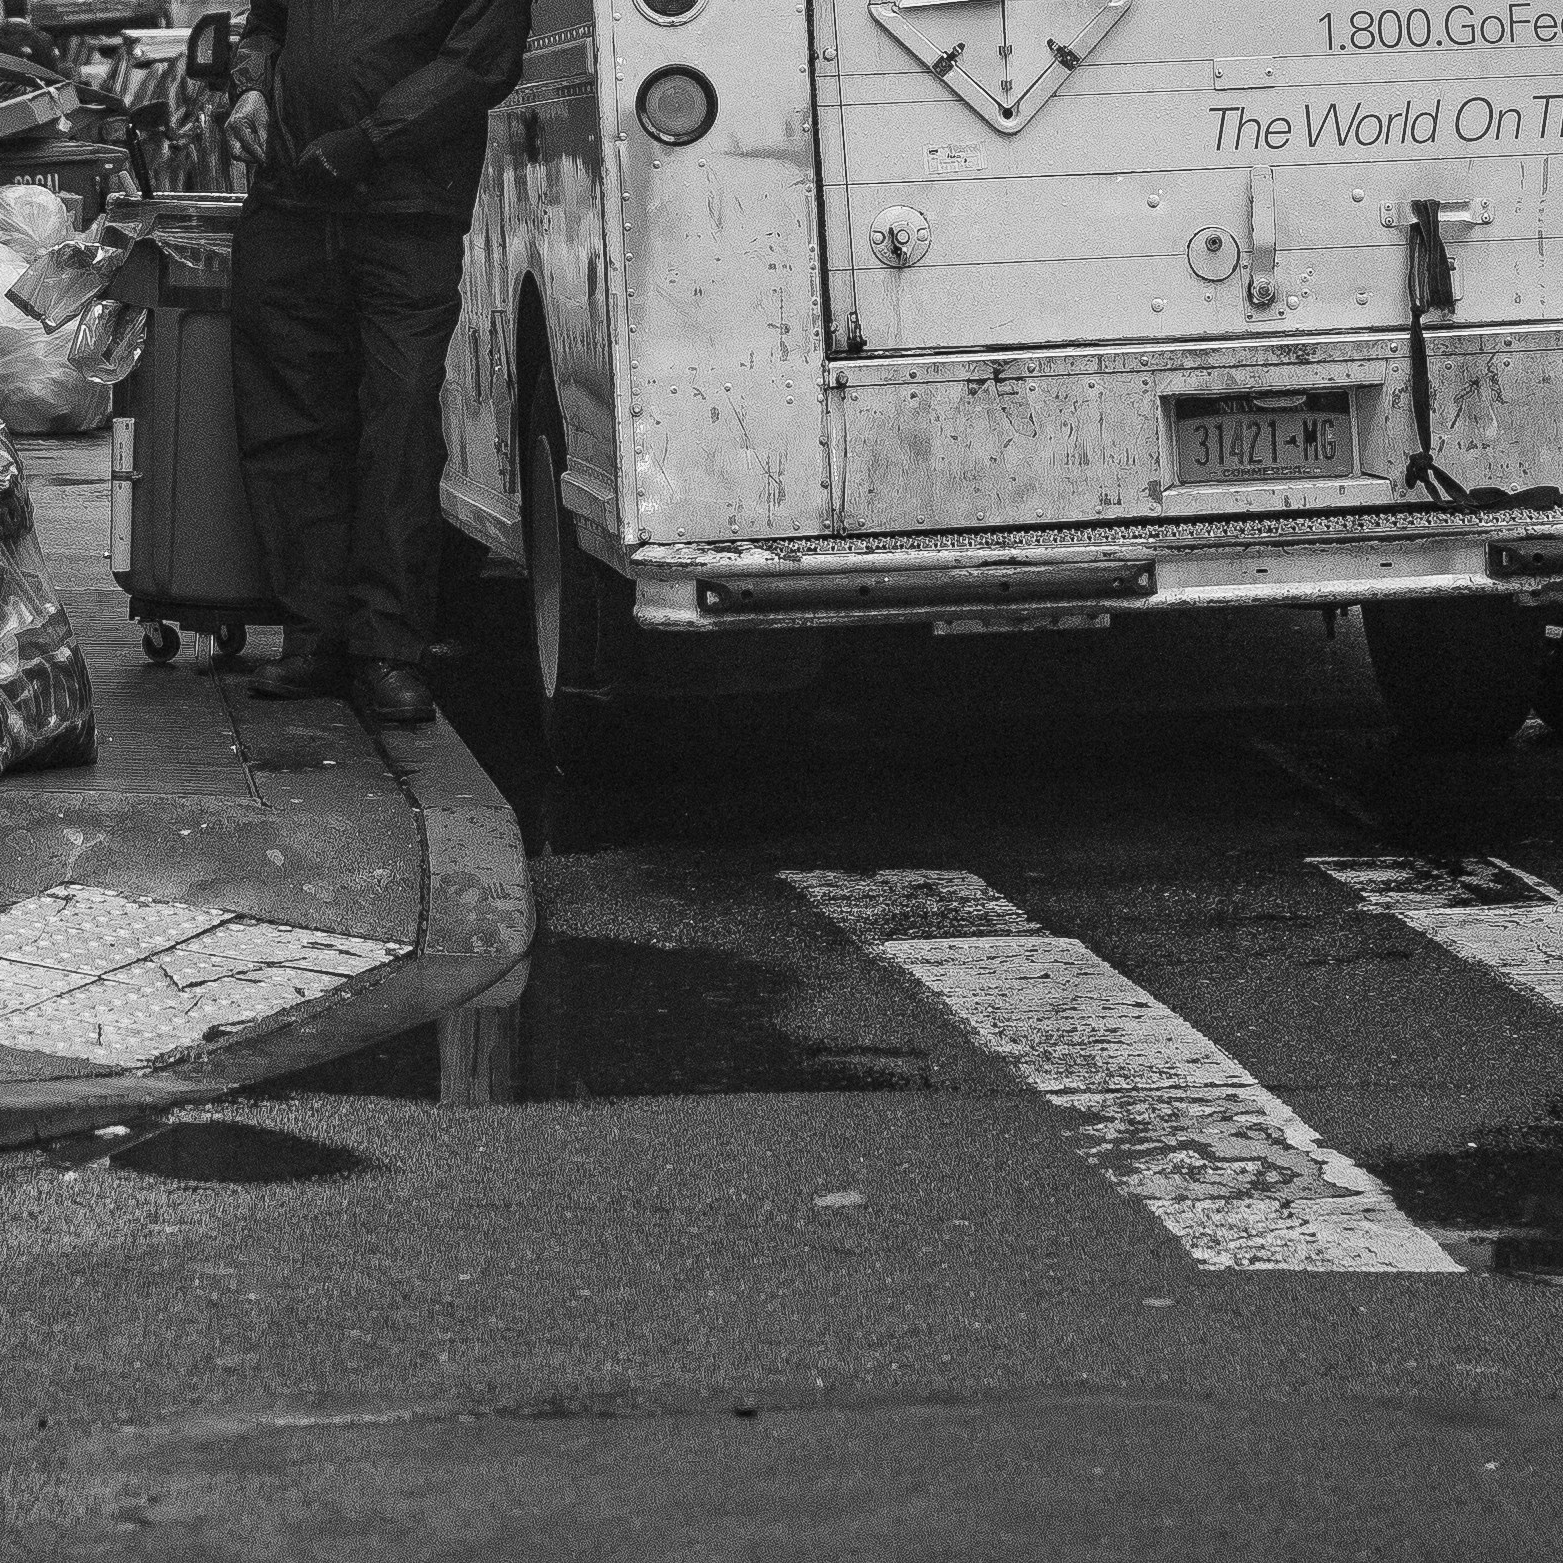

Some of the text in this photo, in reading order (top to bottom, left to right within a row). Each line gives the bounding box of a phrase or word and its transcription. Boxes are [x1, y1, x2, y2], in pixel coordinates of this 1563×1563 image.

[1319, 3, 1563, 51] 1.800.GoFe
[1209, 105, 1293, 151] The
[1304, 98, 1441, 148] World
[1455, 95, 1522, 143] On
